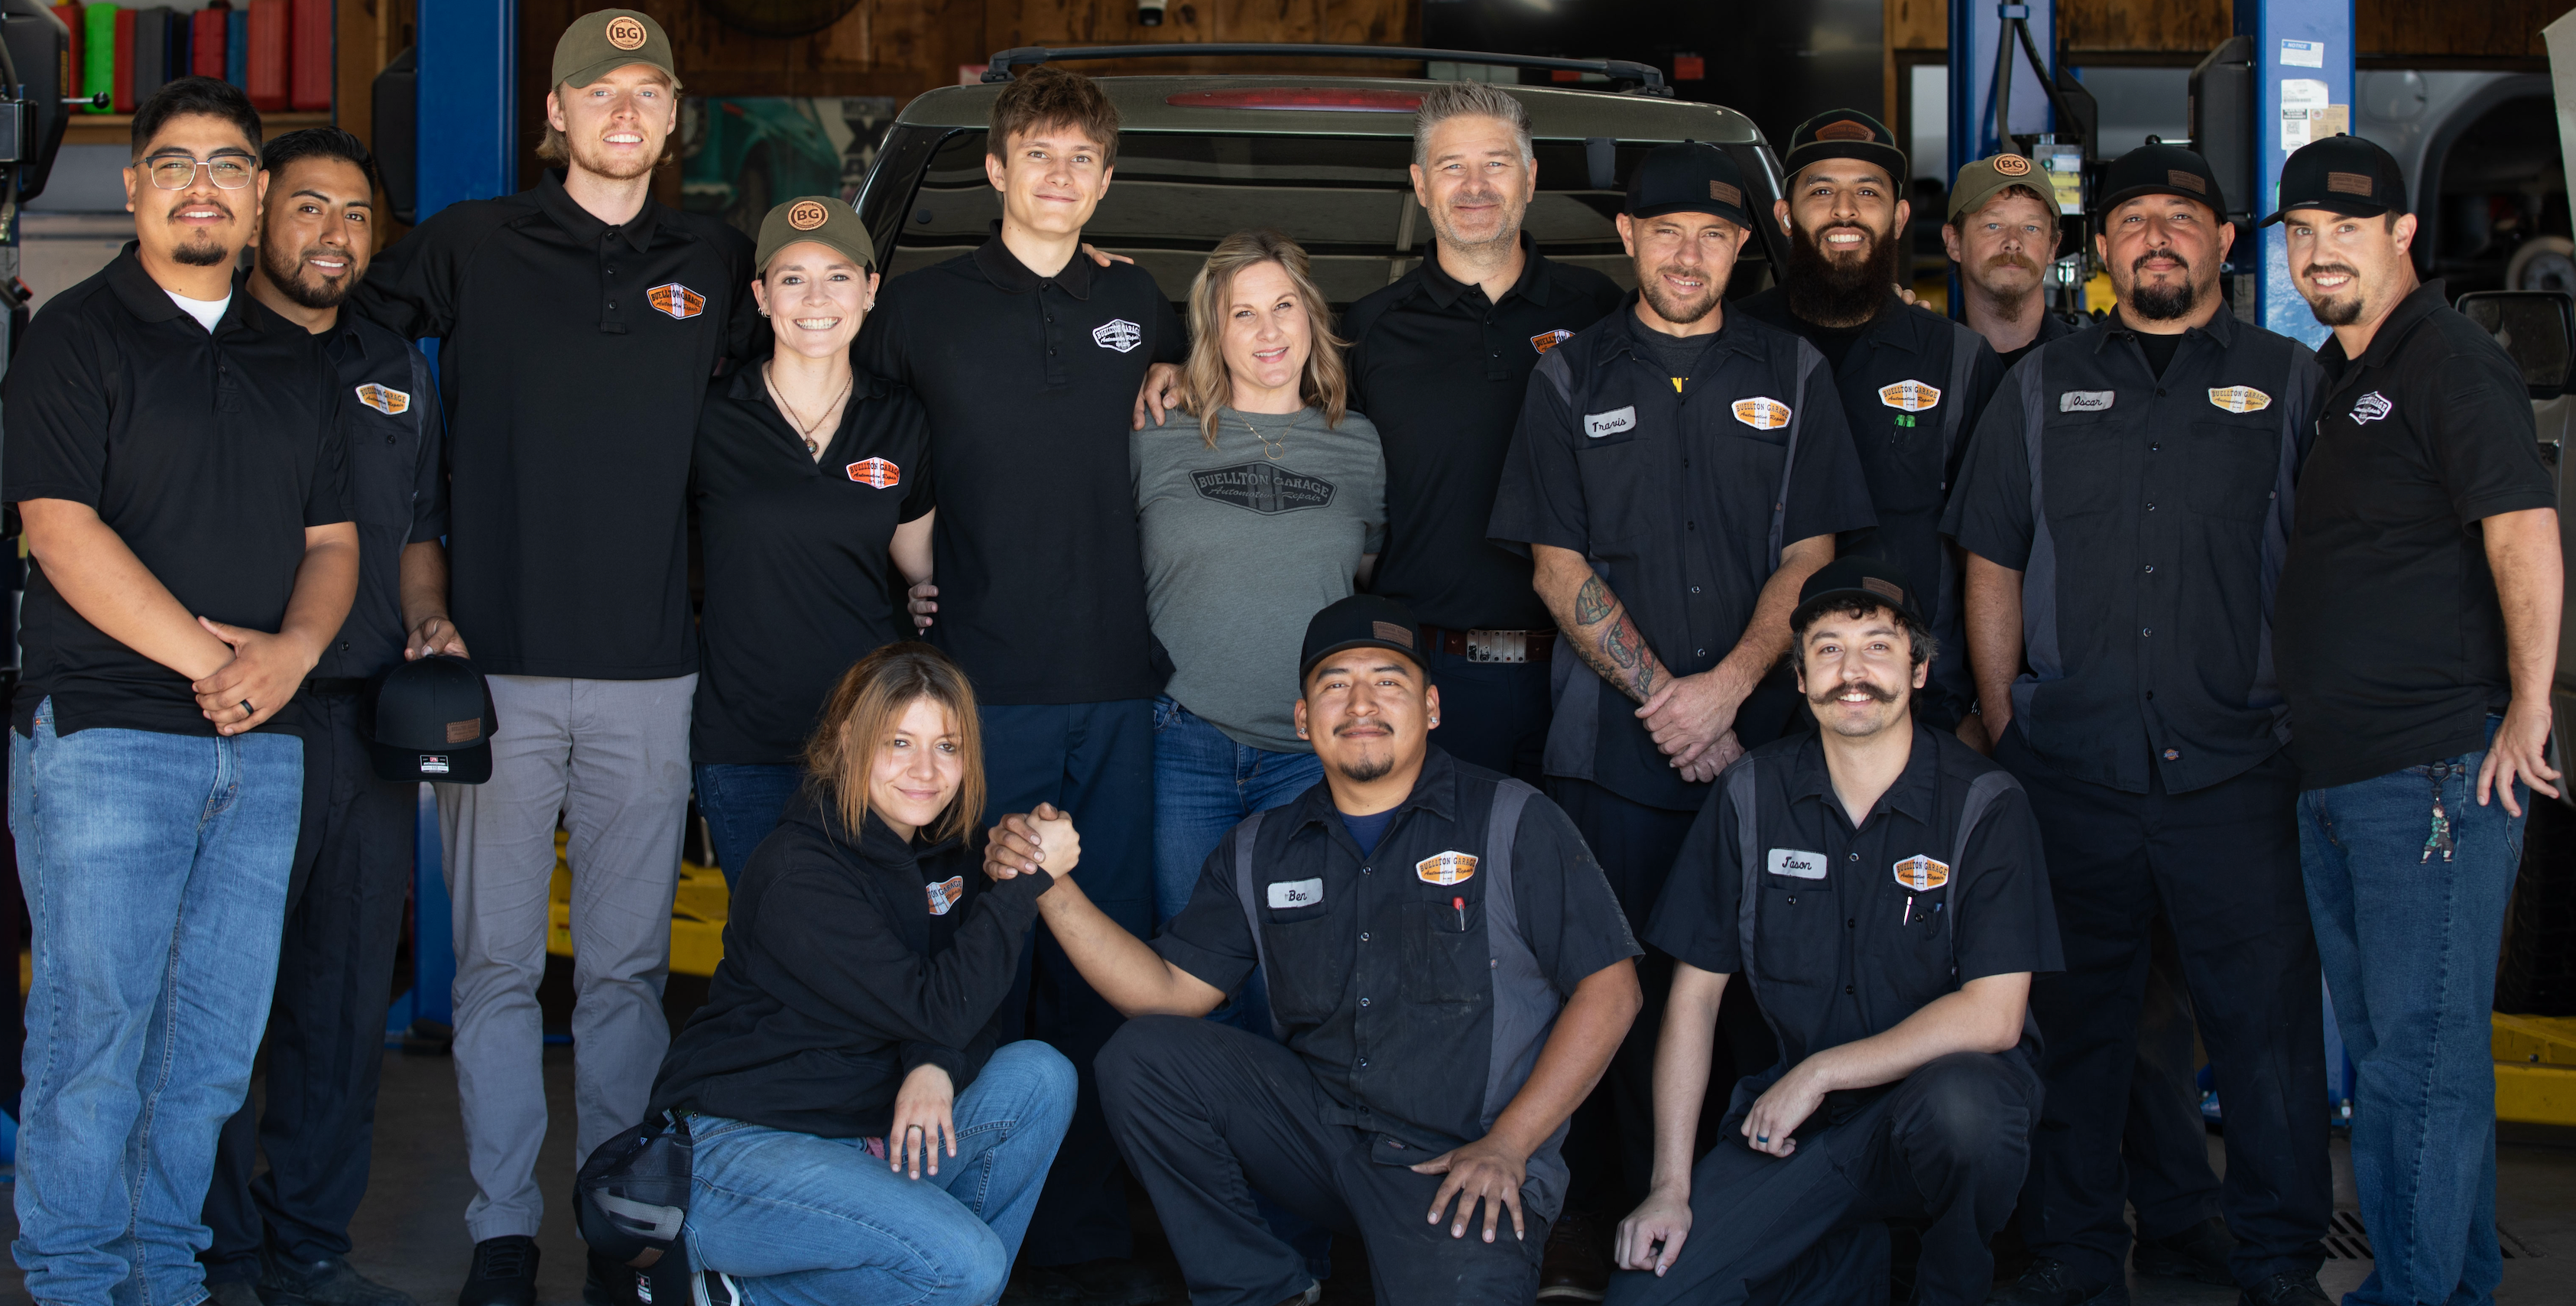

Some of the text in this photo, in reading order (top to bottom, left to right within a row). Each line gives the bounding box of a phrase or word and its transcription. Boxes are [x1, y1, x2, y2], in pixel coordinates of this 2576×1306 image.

[615, 27, 638, 38] BG
[797, 209, 819, 221] BG
[651, 289, 702, 308] BUELLTON GARAGE
[1536, 335, 1565, 347] BUELLTON
[360, 386, 406, 404] BUELLTON GARAGE
[1883, 385, 1938, 399] BUELLTON GARAGE
[2243, 391, 2268, 404] GARAGE
[2073, 395, 2103, 406] Oscar
[1736, 403, 1789, 418] BUELLTON GARAGE
[1592, 417, 1627, 432] Travis
[849, 463, 900, 478] BUELLTON GARAGE
[1197, 472, 1330, 498] BUELLTON GARAGE
[1208, 486, 1322, 502] Automotive Repair
[1419, 857, 1476, 872] BUELLTON GARAGE
[1782, 856, 1812, 870] Jason
[1896, 861, 1948, 876] BUELLTON GARAGE
[938, 880, 962, 895] GARAGE
[1288, 889, 1308, 902] Ben
